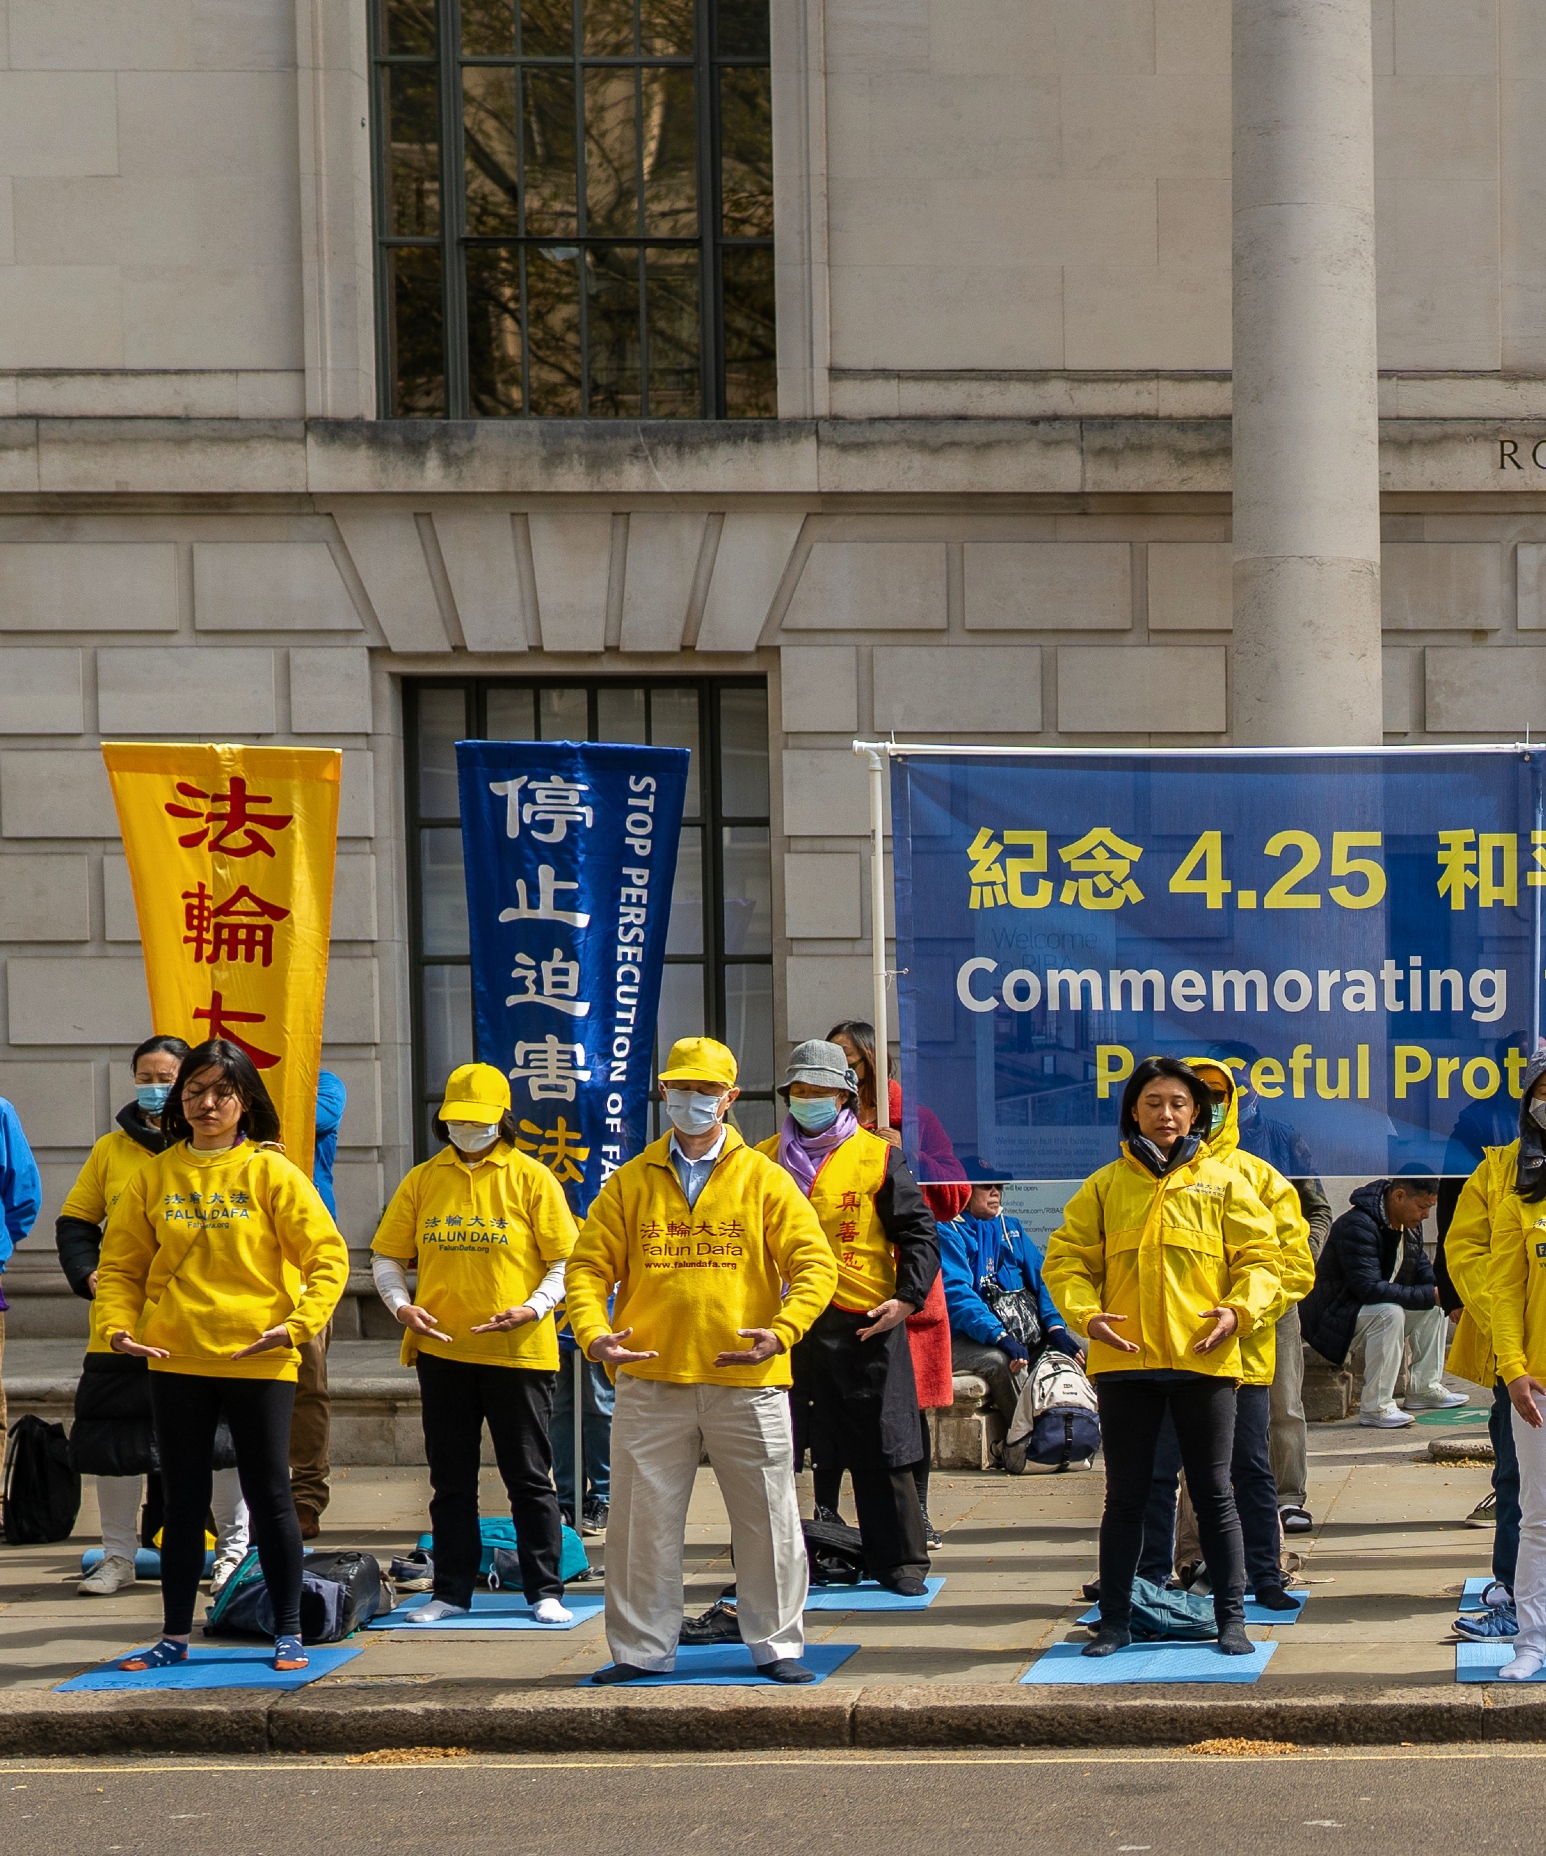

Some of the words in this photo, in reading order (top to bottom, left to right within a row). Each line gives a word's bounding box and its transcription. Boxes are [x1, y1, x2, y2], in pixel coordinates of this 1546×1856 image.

[624, 774, 657, 857] STOP
[966, 826, 1146, 911] 紀念
[1168, 830, 1388, 911] 4.25
[992, 926, 1098, 950] Welcome
[609, 866, 651, 1082] PERSECUTION
[956, 955, 1507, 1022] Commemorating
[1096, 1043, 1370, 1100] Pceful
[605, 1092, 623, 1133] OF
[600, 1144, 621, 1189] FA
[211, 1207, 250, 1220] DAFA
[424, 1214, 509, 1229] 法輪大法
[639, 1219, 746, 1240] 法輪大法
[422, 1230, 467, 1245] FALUN
[470, 1231, 509, 1246] DAFA
[642, 1243, 691, 1257] Falun
[696, 1242, 743, 1257] Dafa
[644, 1260, 737, 1270] www.falundafa.org
